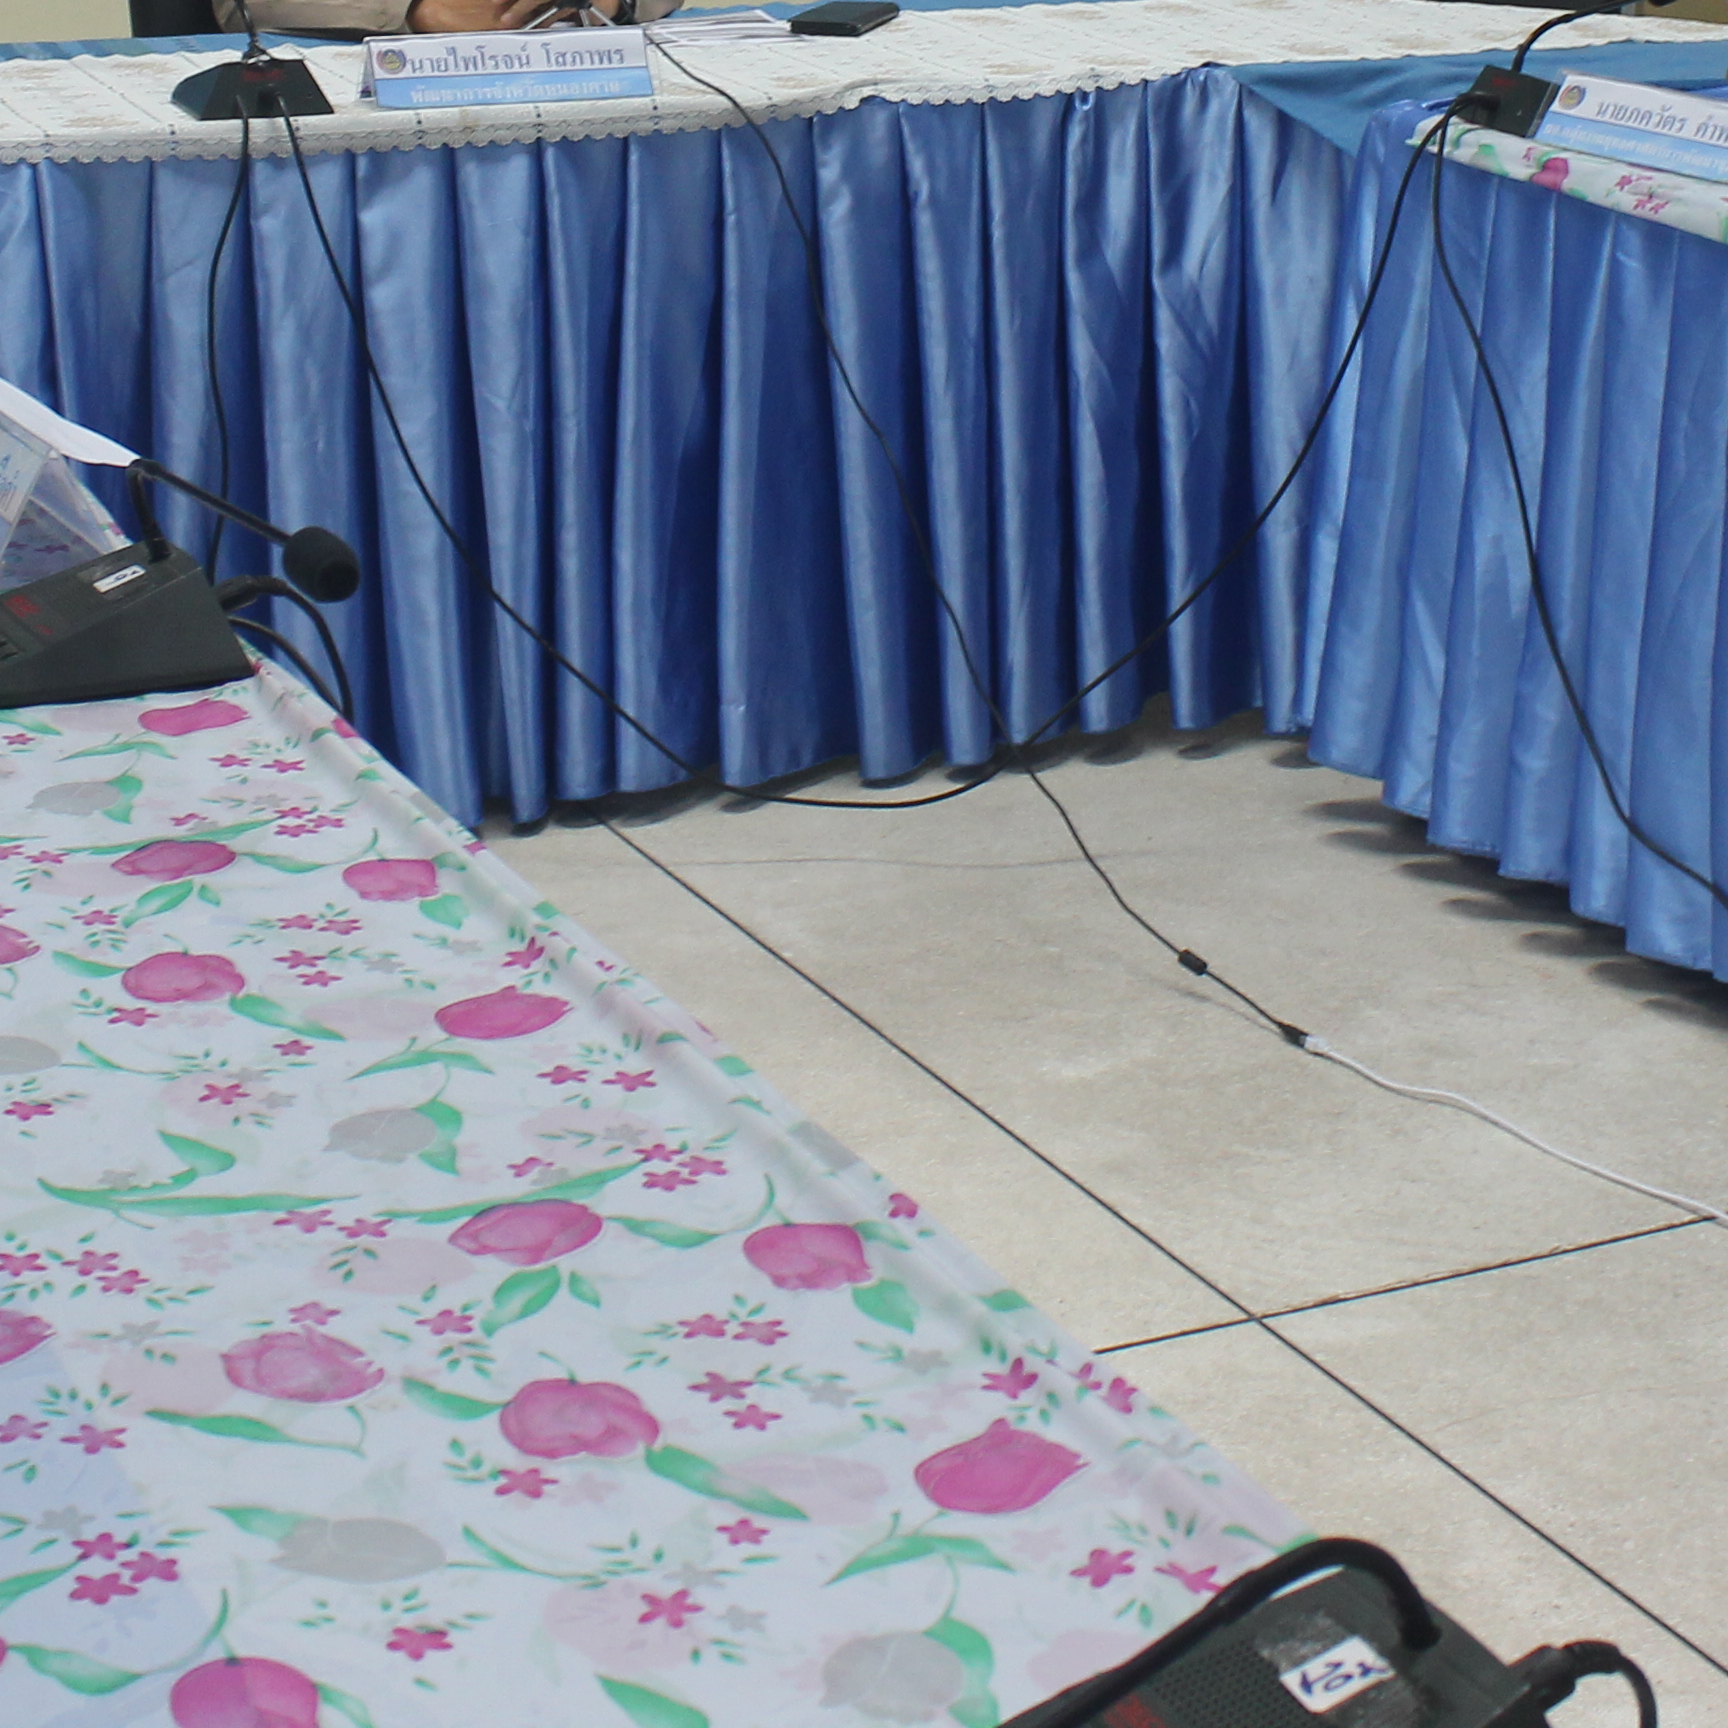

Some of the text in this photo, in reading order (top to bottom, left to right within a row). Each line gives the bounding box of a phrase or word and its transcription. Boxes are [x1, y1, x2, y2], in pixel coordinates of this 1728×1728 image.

[407, 41, 626, 75] นายไพโรจน์ โสภาพร
